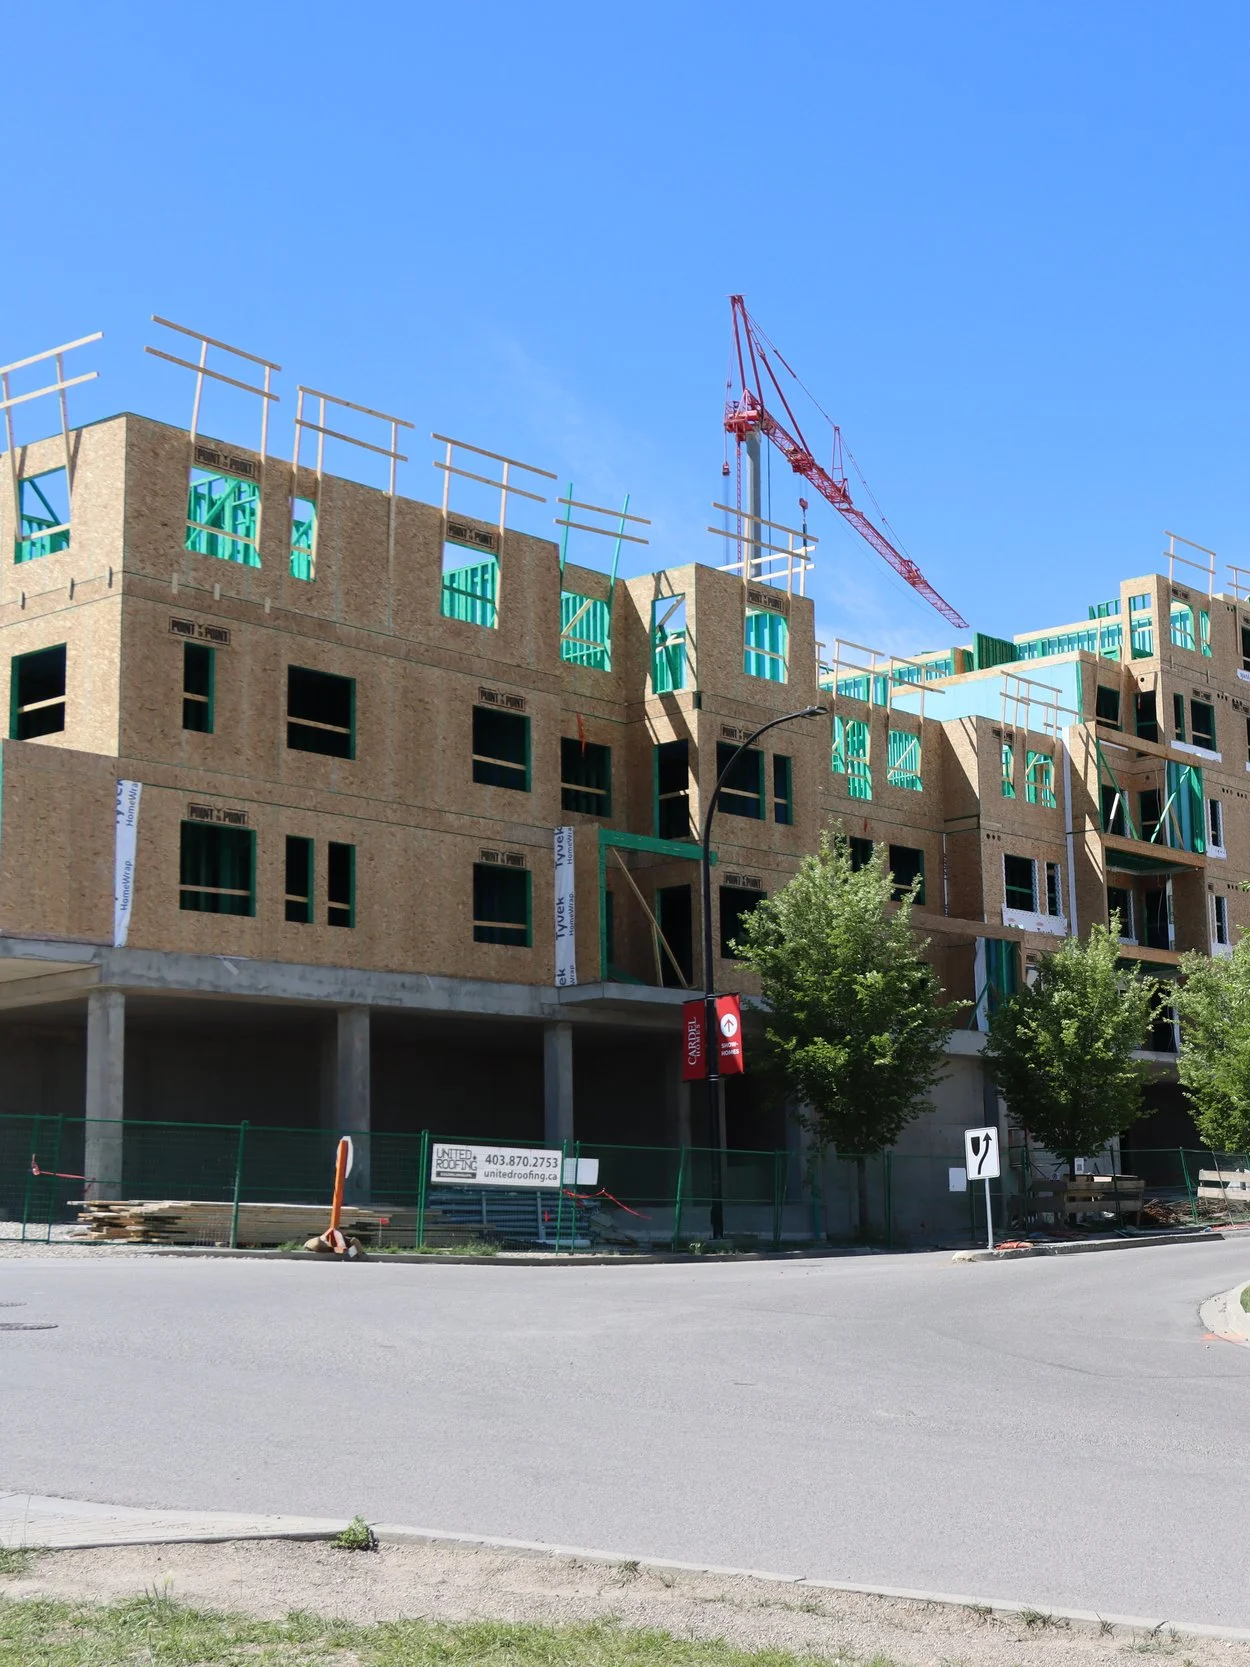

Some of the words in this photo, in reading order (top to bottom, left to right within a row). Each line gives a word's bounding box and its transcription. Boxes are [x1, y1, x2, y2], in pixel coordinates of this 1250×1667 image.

[554, 826, 565, 867] Tyvek
[556, 897, 568, 940] Tyvek
[688, 1017, 696, 1065] CARDEL
[436, 1148, 472, 1159] UNITED
[436, 1159, 477, 1170] ROOFING
[485, 1154, 558, 1168] 403.870.2753
[484, 1169, 557, 1182] unitedroofing.ca
